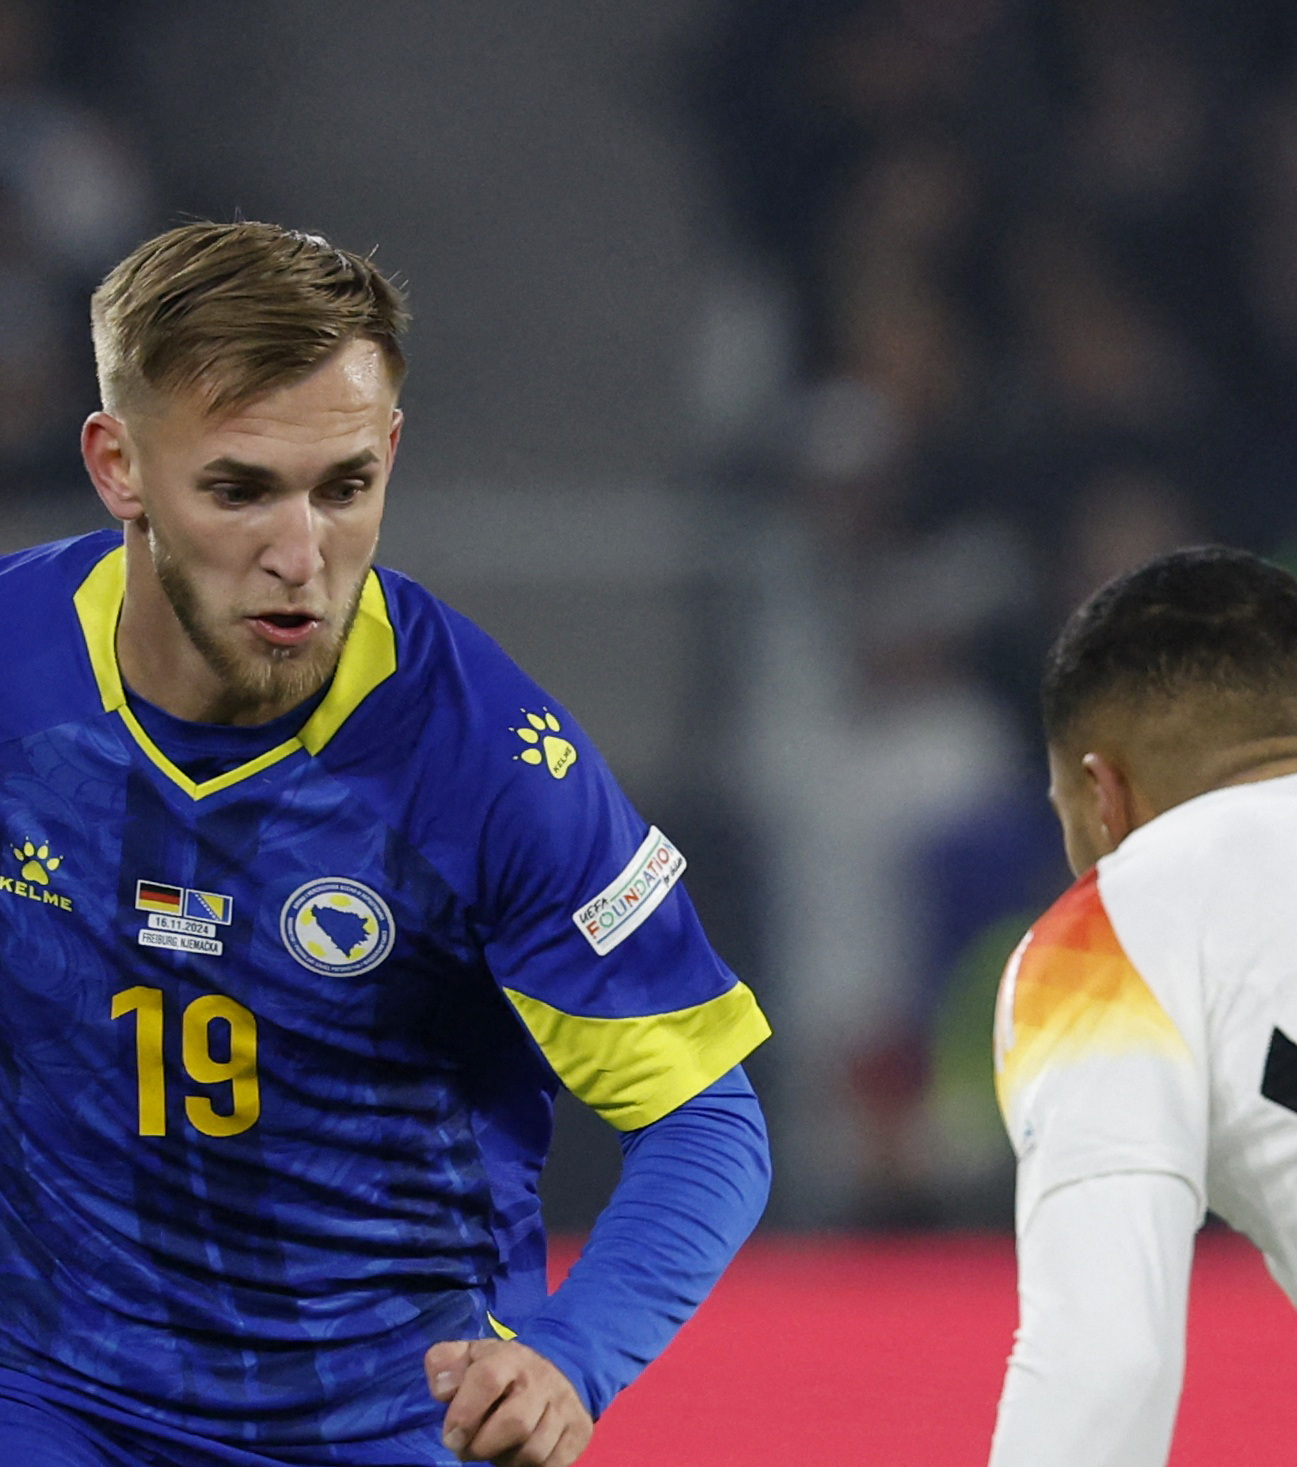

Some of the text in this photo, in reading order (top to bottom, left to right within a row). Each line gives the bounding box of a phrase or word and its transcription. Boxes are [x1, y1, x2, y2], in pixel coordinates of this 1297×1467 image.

[579, 897, 609, 924] UEFA
[155, 917, 209, 934] 16.11.2024
[109, 985, 260, 1137] 19
